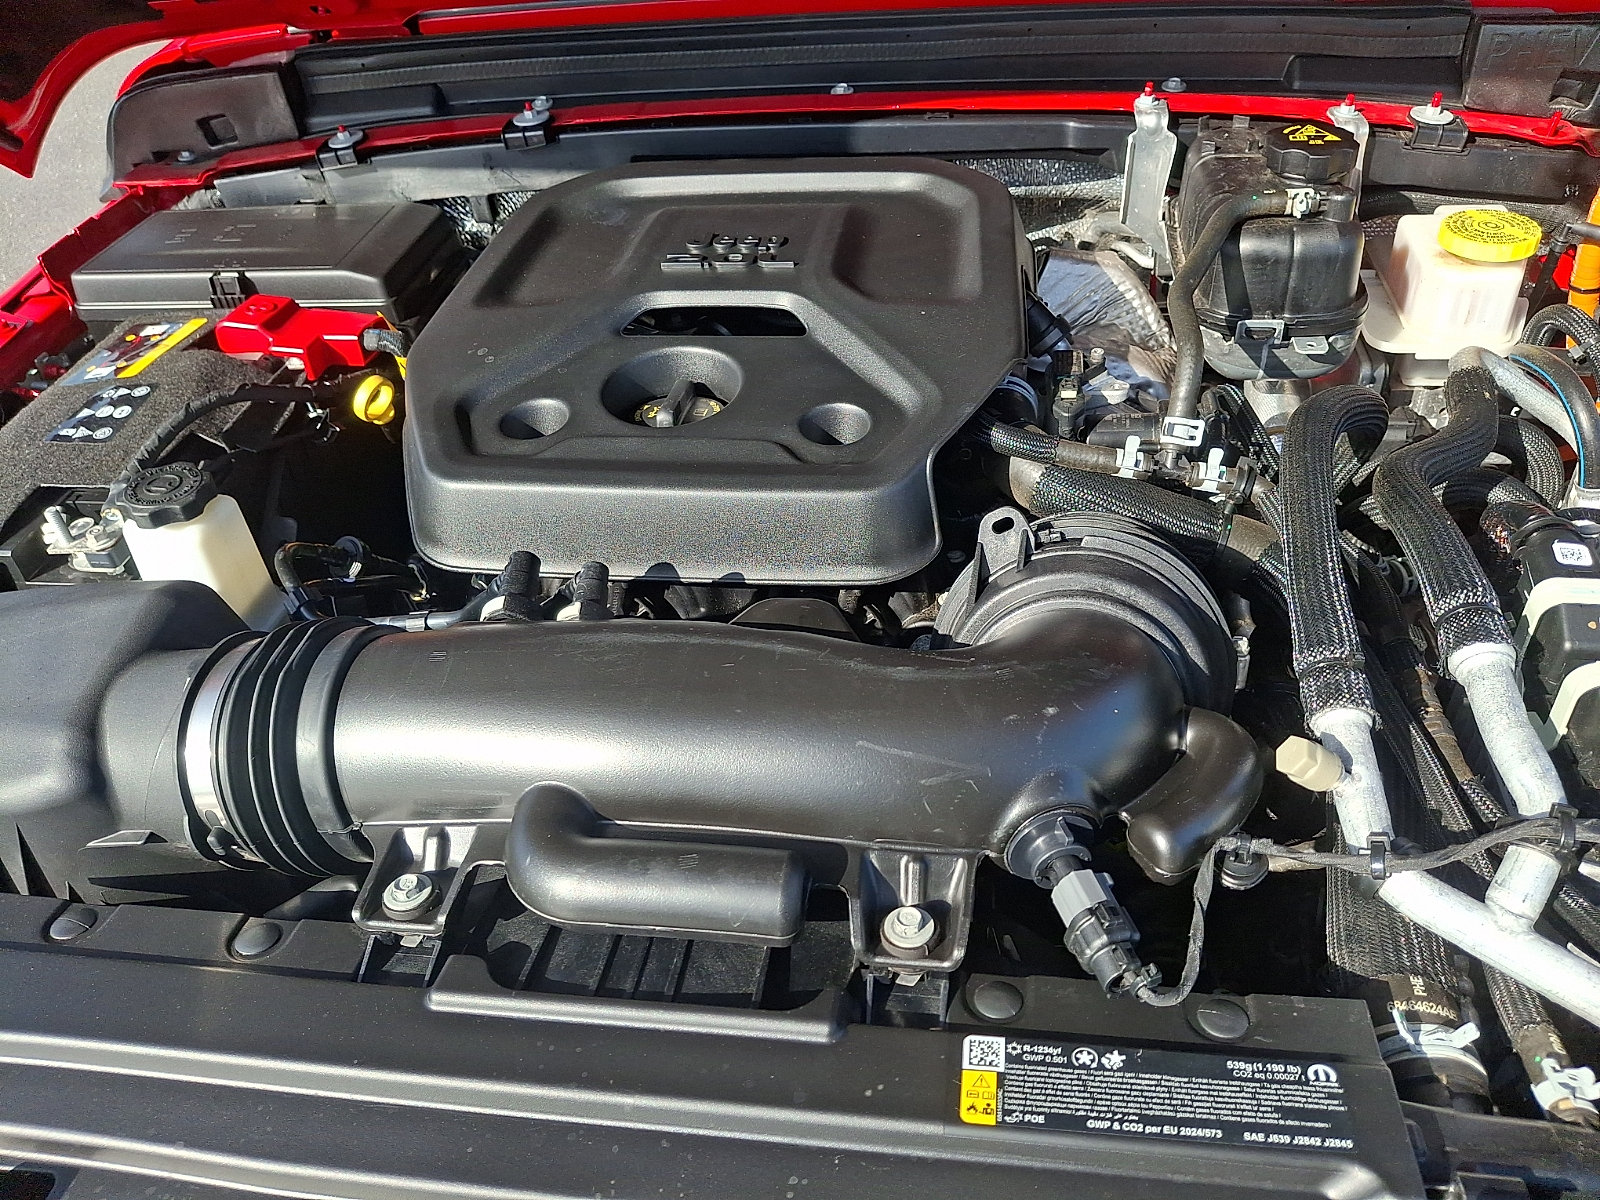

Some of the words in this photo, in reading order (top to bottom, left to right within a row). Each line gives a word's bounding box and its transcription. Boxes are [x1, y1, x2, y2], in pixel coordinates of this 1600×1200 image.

[1022, 1044, 1062, 1055] R-1234yf
[1022, 1053, 1044, 1061] GWP
[1045, 1055, 1068, 1064] 0.501
[1226, 1060, 1253, 1071] 539g
[1286, 1064, 1302, 1074] lb)
[1233, 1069, 1253, 1078] CO2
[1254, 1072, 1265, 1080] eq
[1266, 1072, 1300, 1081] 0.00027
[1023, 1114, 1046, 1124] POE
[1086, 1119, 1111, 1129] GWP
[1112, 1121, 1120, 1130] &
[1121, 1122, 1144, 1132] CO2
[1144, 1125, 1161, 1134] per
[1162, 1125, 1178, 1135] EU
[1179, 1127, 1223, 1139] 2024/573
[1243, 1132, 1265, 1142] SAE
[1267, 1133, 1291, 1144] J639
[1293, 1135, 1322, 1146] J2842
[1323, 1138, 1354, 1149] J2845
